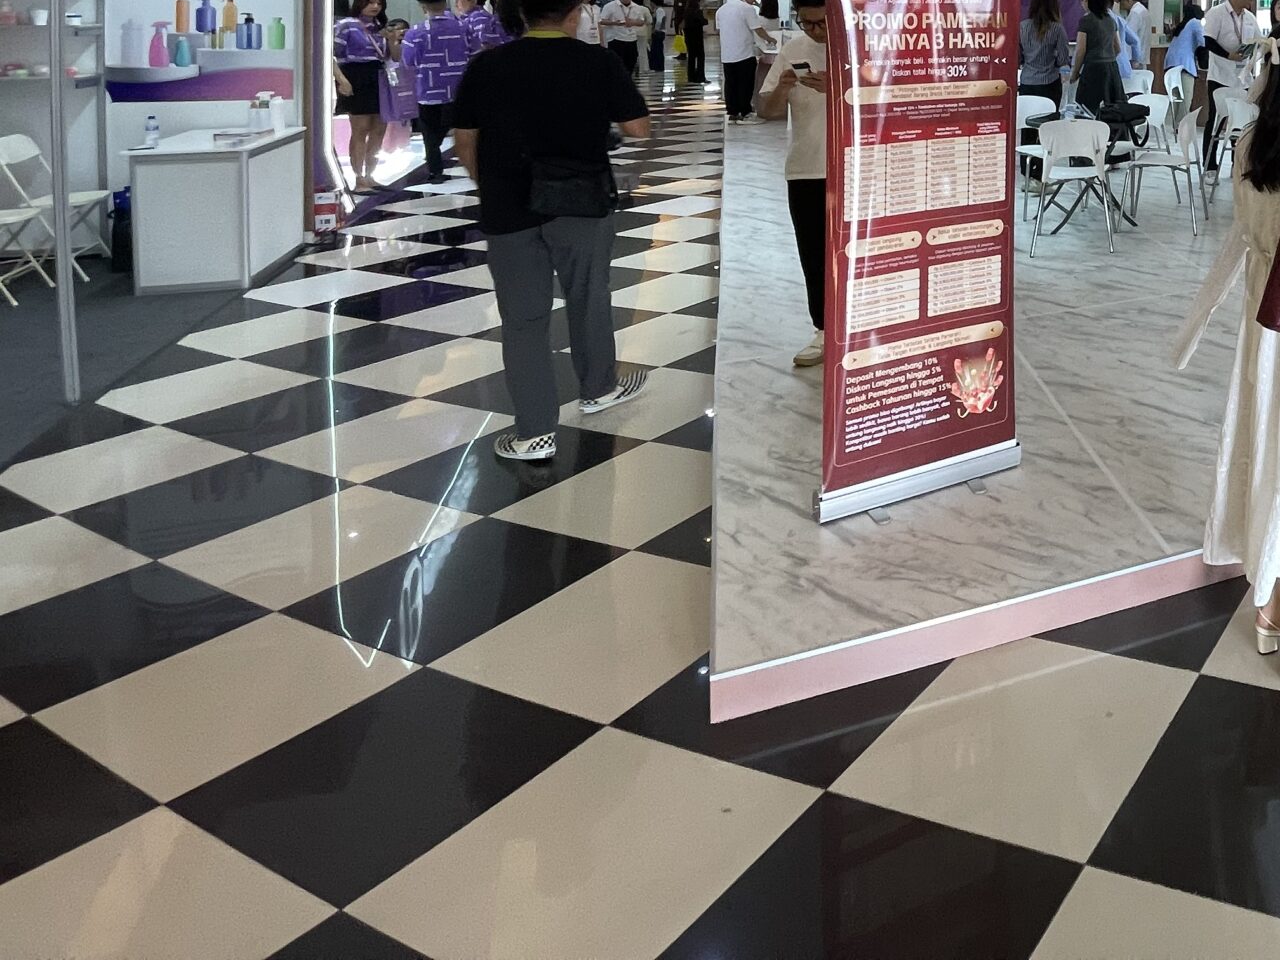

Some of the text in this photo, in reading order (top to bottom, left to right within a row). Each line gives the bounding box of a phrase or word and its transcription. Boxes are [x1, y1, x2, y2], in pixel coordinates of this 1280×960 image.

[846, 11, 1008, 30] PROMO PAMERAN
[865, 31, 996, 51] HANYA 3 HARI!
[947, 65, 967, 77] 30%
[970, 54, 990, 64] untung!
[846, 357, 938, 385] Deposit Mengembang 10%
[846, 366, 941, 394] Diskon Langsung hingga 5%
[846, 375, 944, 405] untuk Pemesanan di Tempat
[846, 382, 952, 415] Cashback Tahunan hingga 15%
